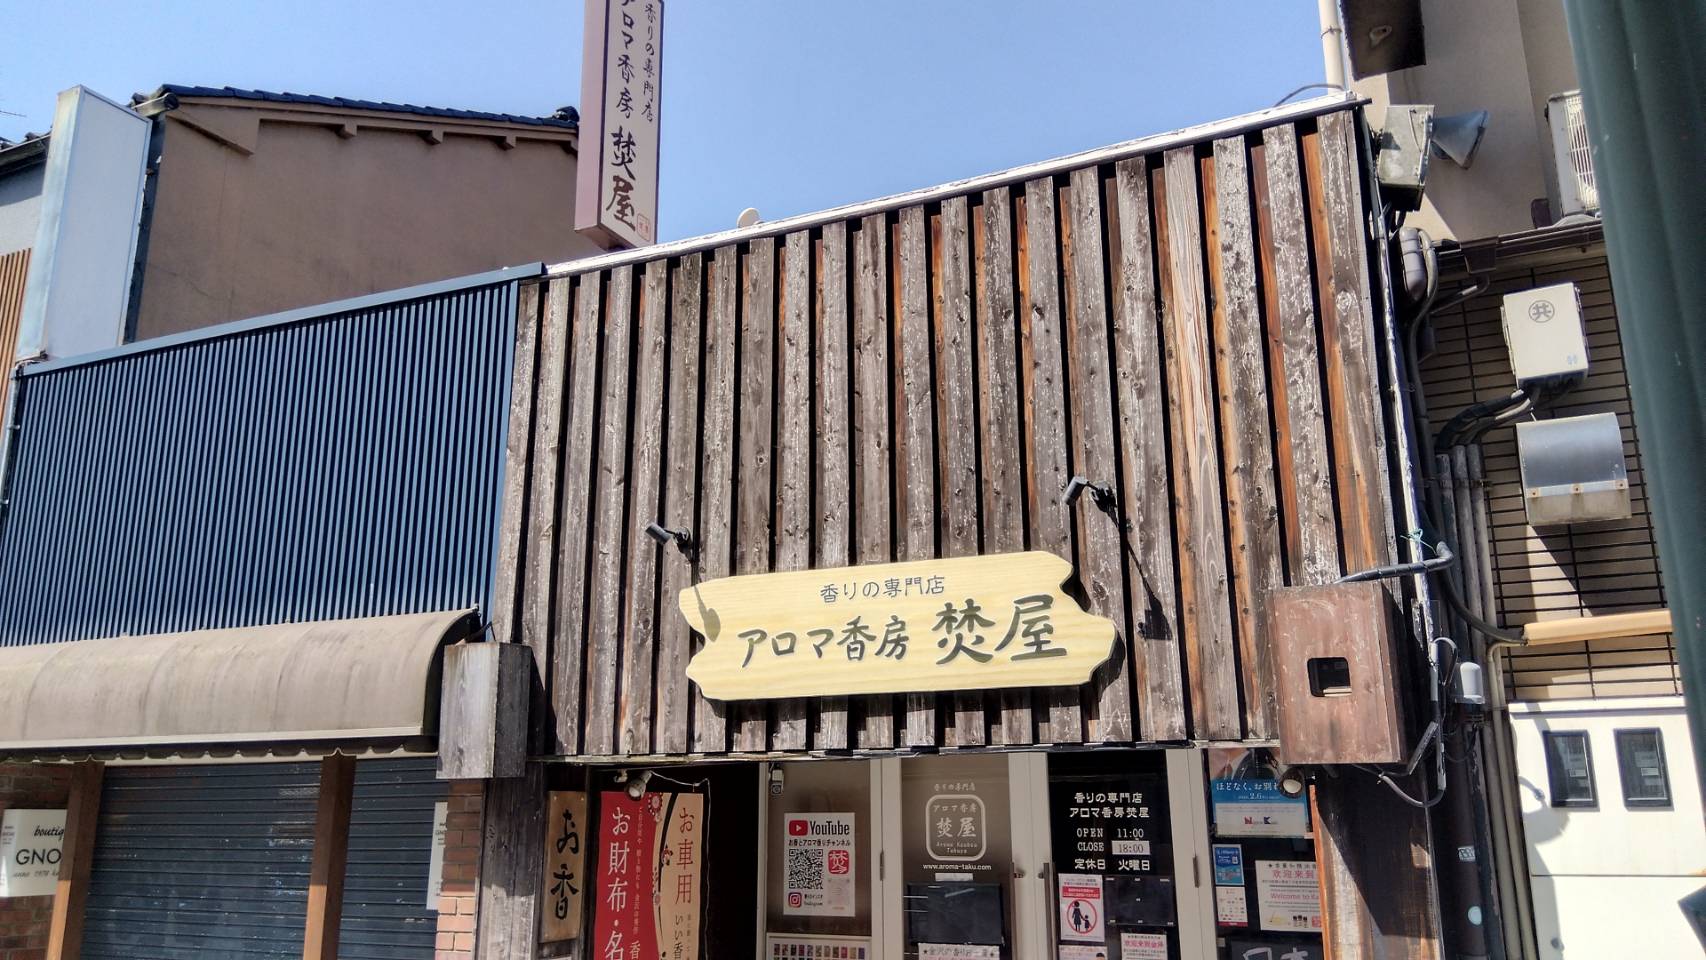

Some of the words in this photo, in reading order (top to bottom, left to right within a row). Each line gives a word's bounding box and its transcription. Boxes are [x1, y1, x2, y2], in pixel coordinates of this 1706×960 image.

[606, 126, 636, 232] 焚屋
[819, 575, 945, 604] 香りの専門店
[737, 614, 909, 669] アロマ香房
[931, 594, 1067, 666] 焚屋
[1074, 792, 1143, 804] 香りの専門店
[809, 820, 850, 836] YouTube
[936, 817, 977, 838] 焚屋
[1076, 828, 1104, 838] OPEN
[1117, 828, 1144, 839] 11:00
[1077, 842, 1105, 852] CLOSE
[1118, 843, 1144, 853] 18:00
[922, 863, 992, 871] www.aroma-taku.com
[1074, 858, 1106, 870] 定休日
[1118, 859, 1150, 871] 火曜日
